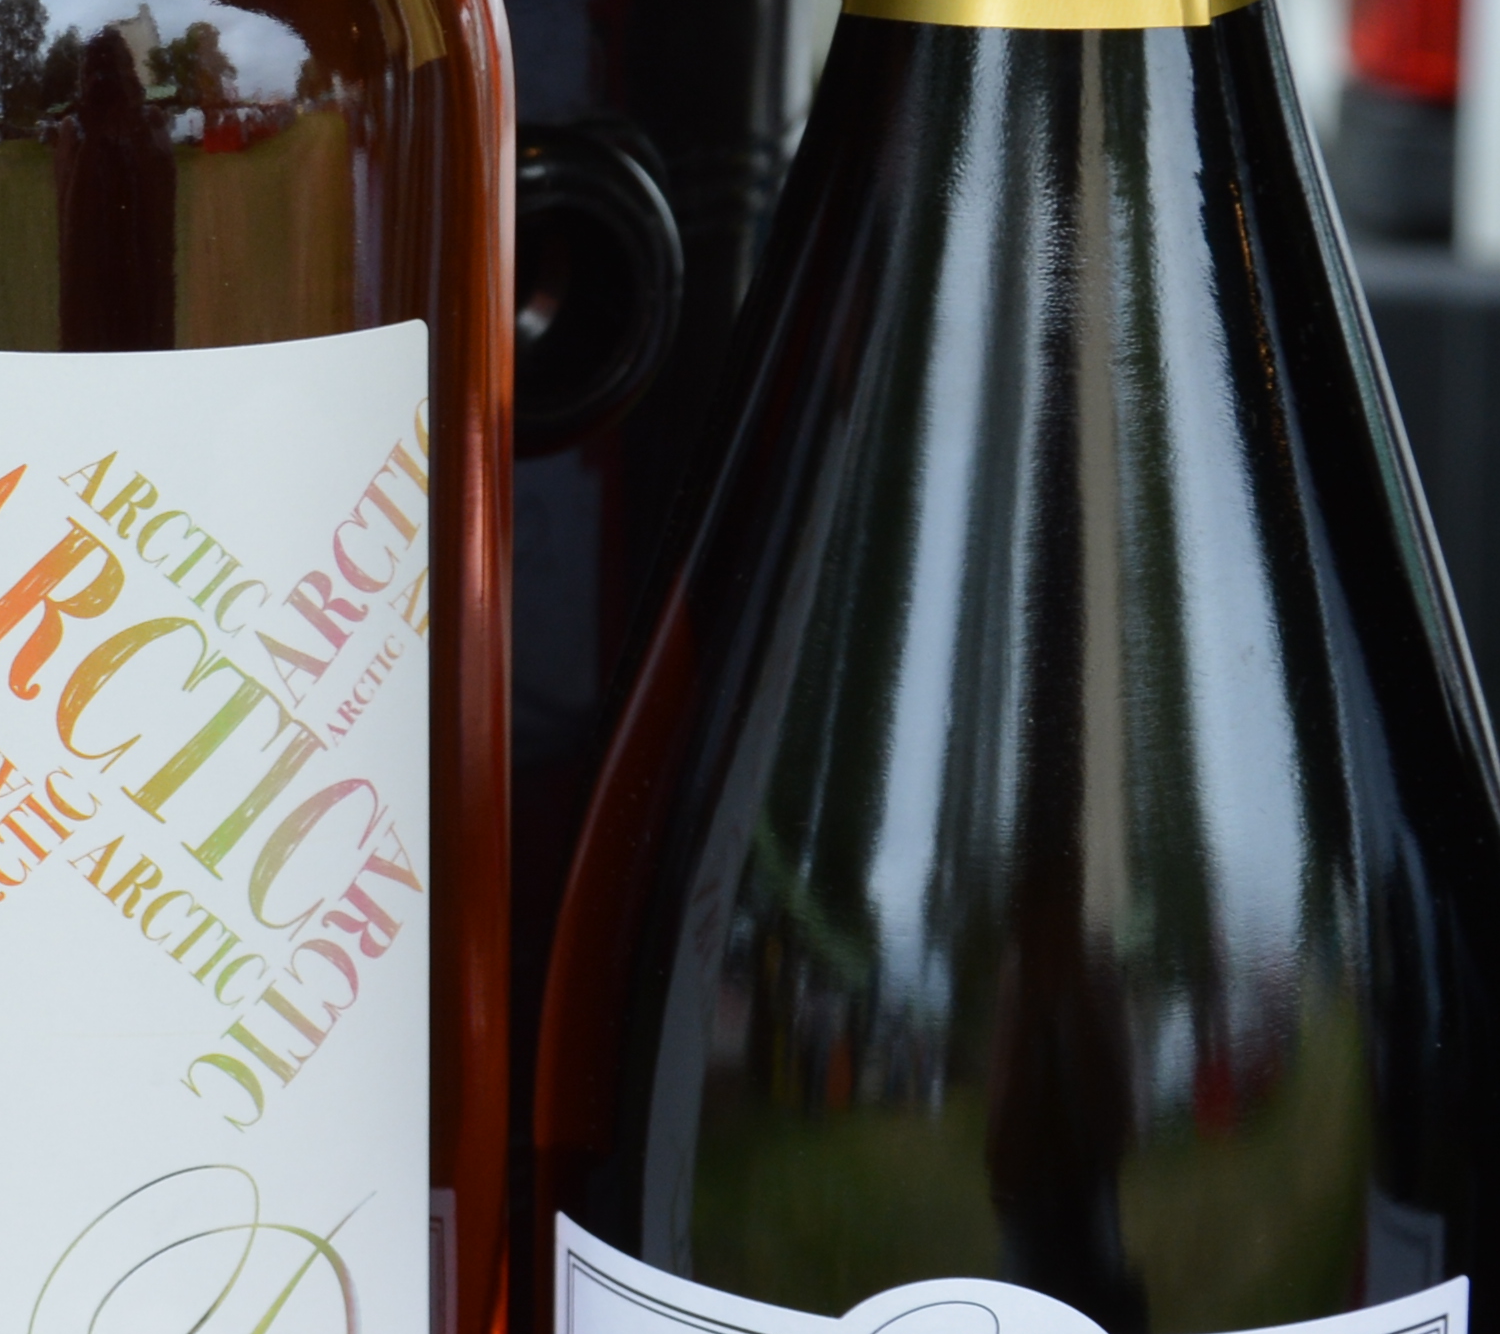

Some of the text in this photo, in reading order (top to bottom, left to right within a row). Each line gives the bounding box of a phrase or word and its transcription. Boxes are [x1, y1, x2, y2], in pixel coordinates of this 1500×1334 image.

[58, 450, 272, 638] ARCTIC
[324, 634, 405, 747] ARCTIC
[67, 834, 270, 1009] ARCTIC
[180, 821, 424, 1134] ARCTIC
